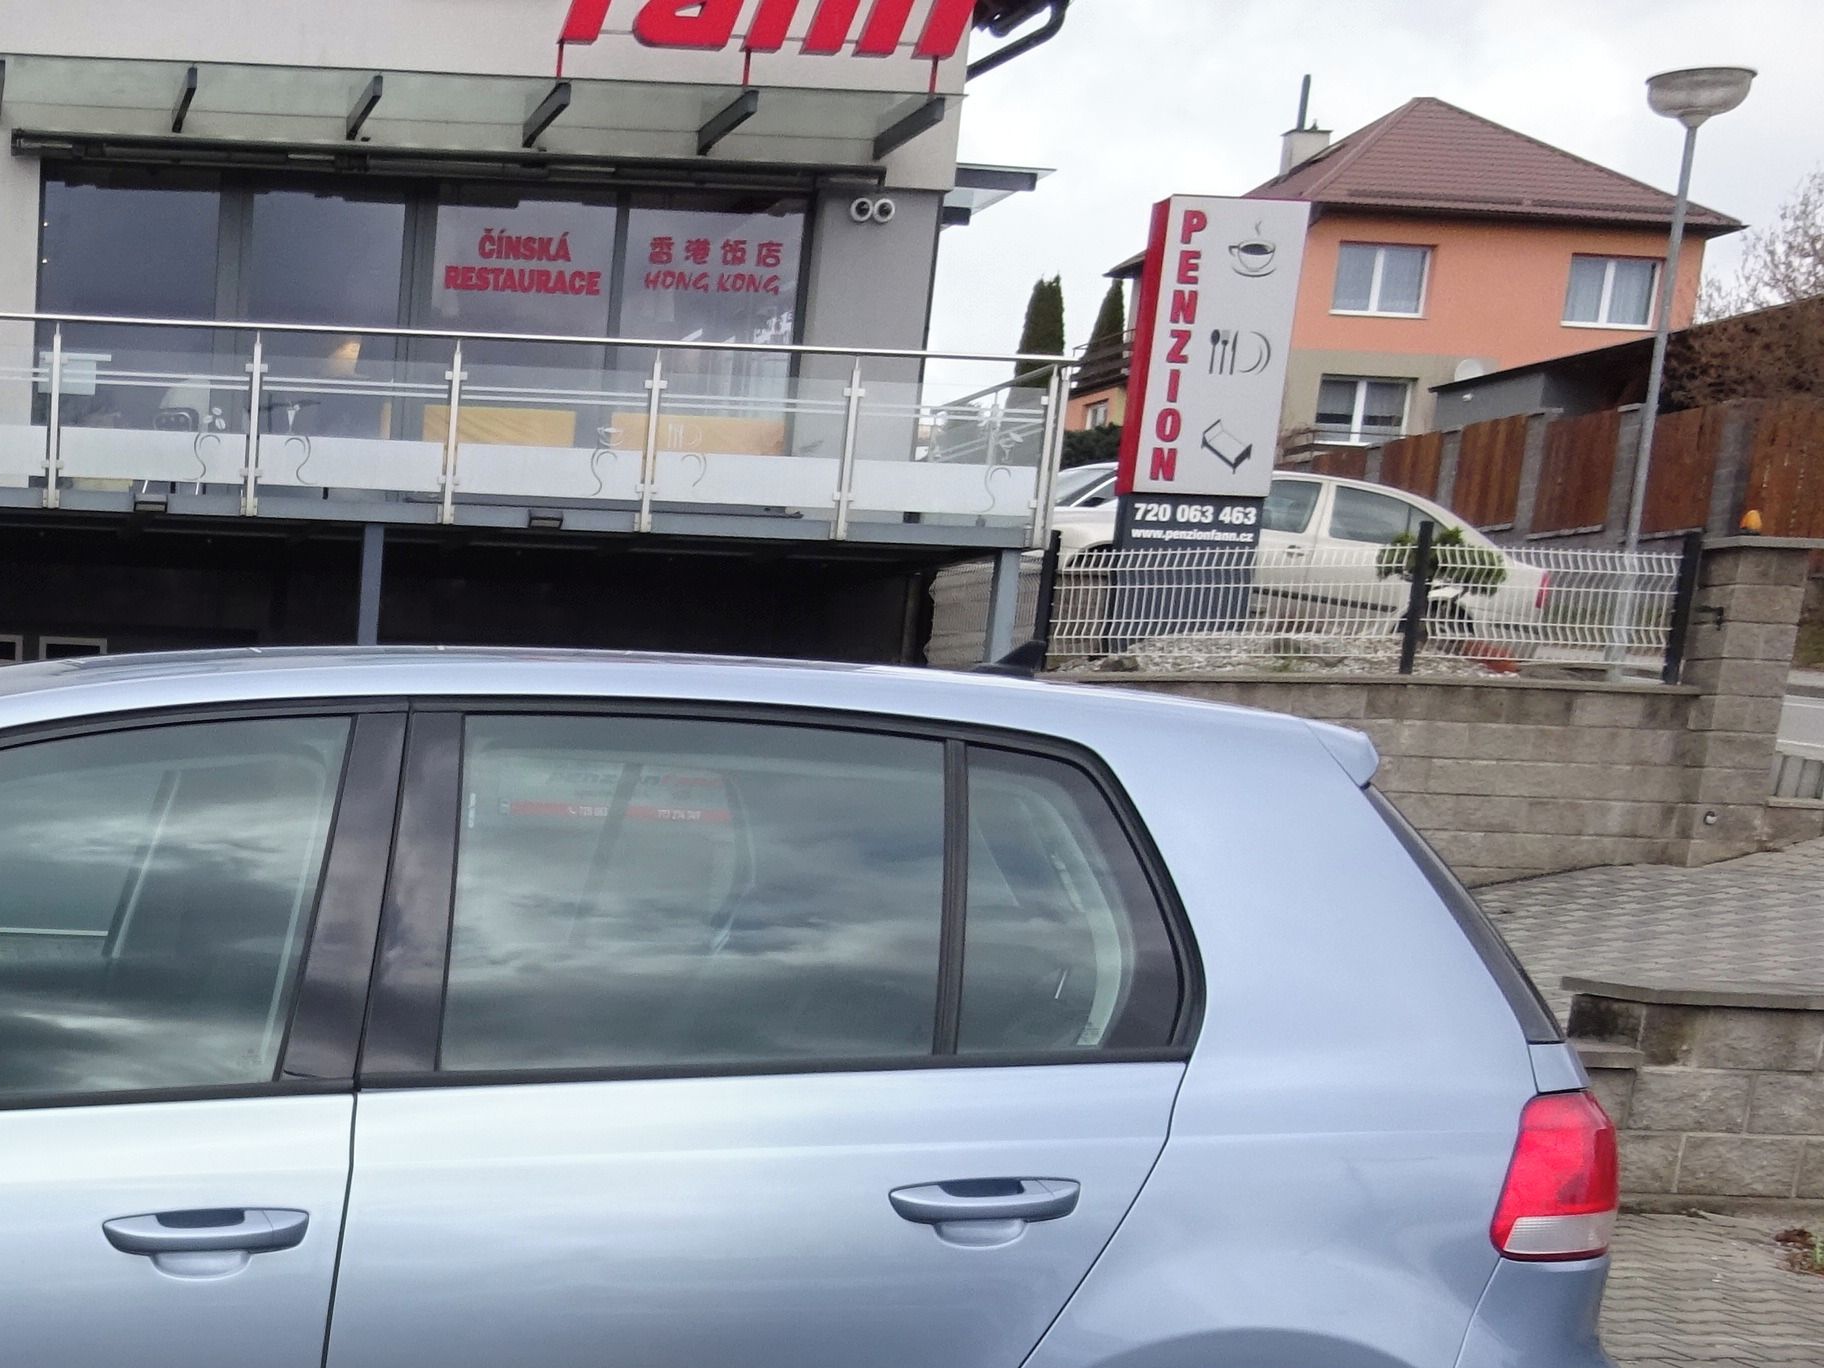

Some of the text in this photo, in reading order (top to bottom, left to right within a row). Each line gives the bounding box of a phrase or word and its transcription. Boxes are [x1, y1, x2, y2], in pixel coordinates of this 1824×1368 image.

[478, 228, 571, 262] ČÍNSKÁ
[444, 265, 602, 296] RESTAURACE
[644, 270, 781, 295] HONG KONG
[1149, 210, 1207, 481] PENZION
[1134, 503, 1257, 525] 720 063 463
[1131, 528, 1254, 542] www.penzionfann.cz
